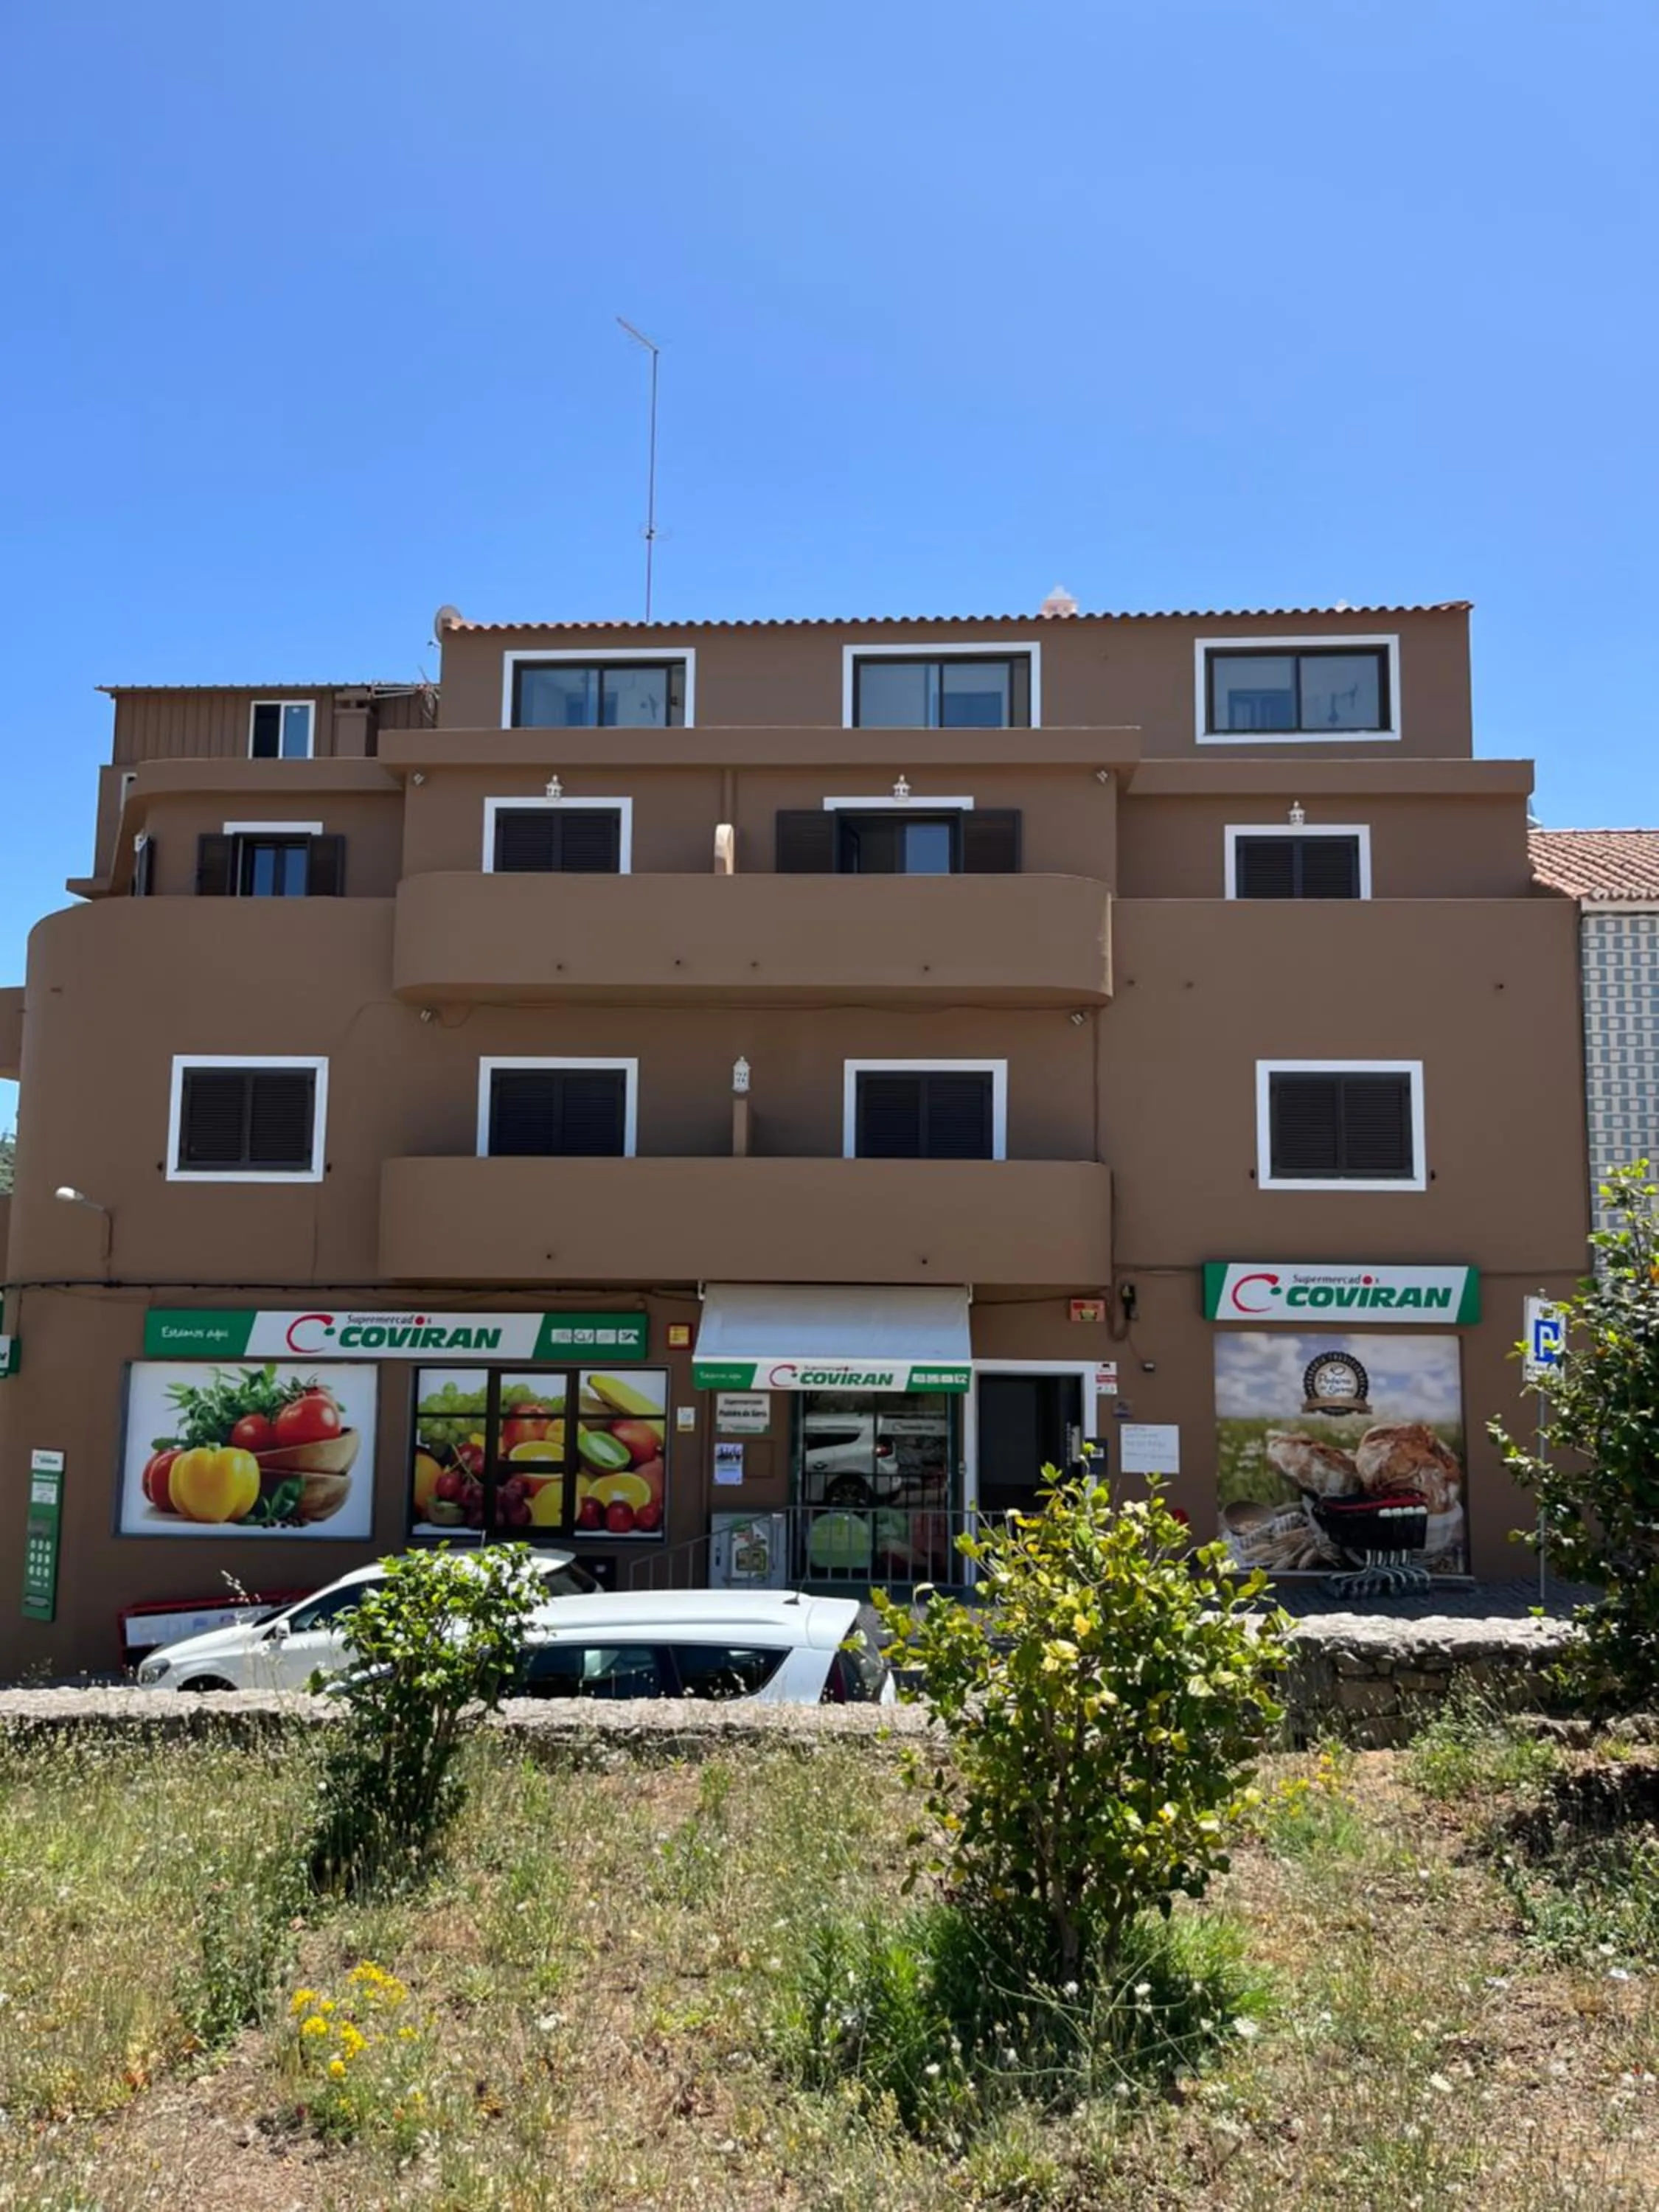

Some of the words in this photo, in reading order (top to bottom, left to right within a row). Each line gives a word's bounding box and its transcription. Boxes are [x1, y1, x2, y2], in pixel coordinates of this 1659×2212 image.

[1286, 1286, 1452, 1307] COVIRAN
[339, 1326, 502, 1349] COVIRAN
[800, 1371, 894, 1385] COVIRAN
